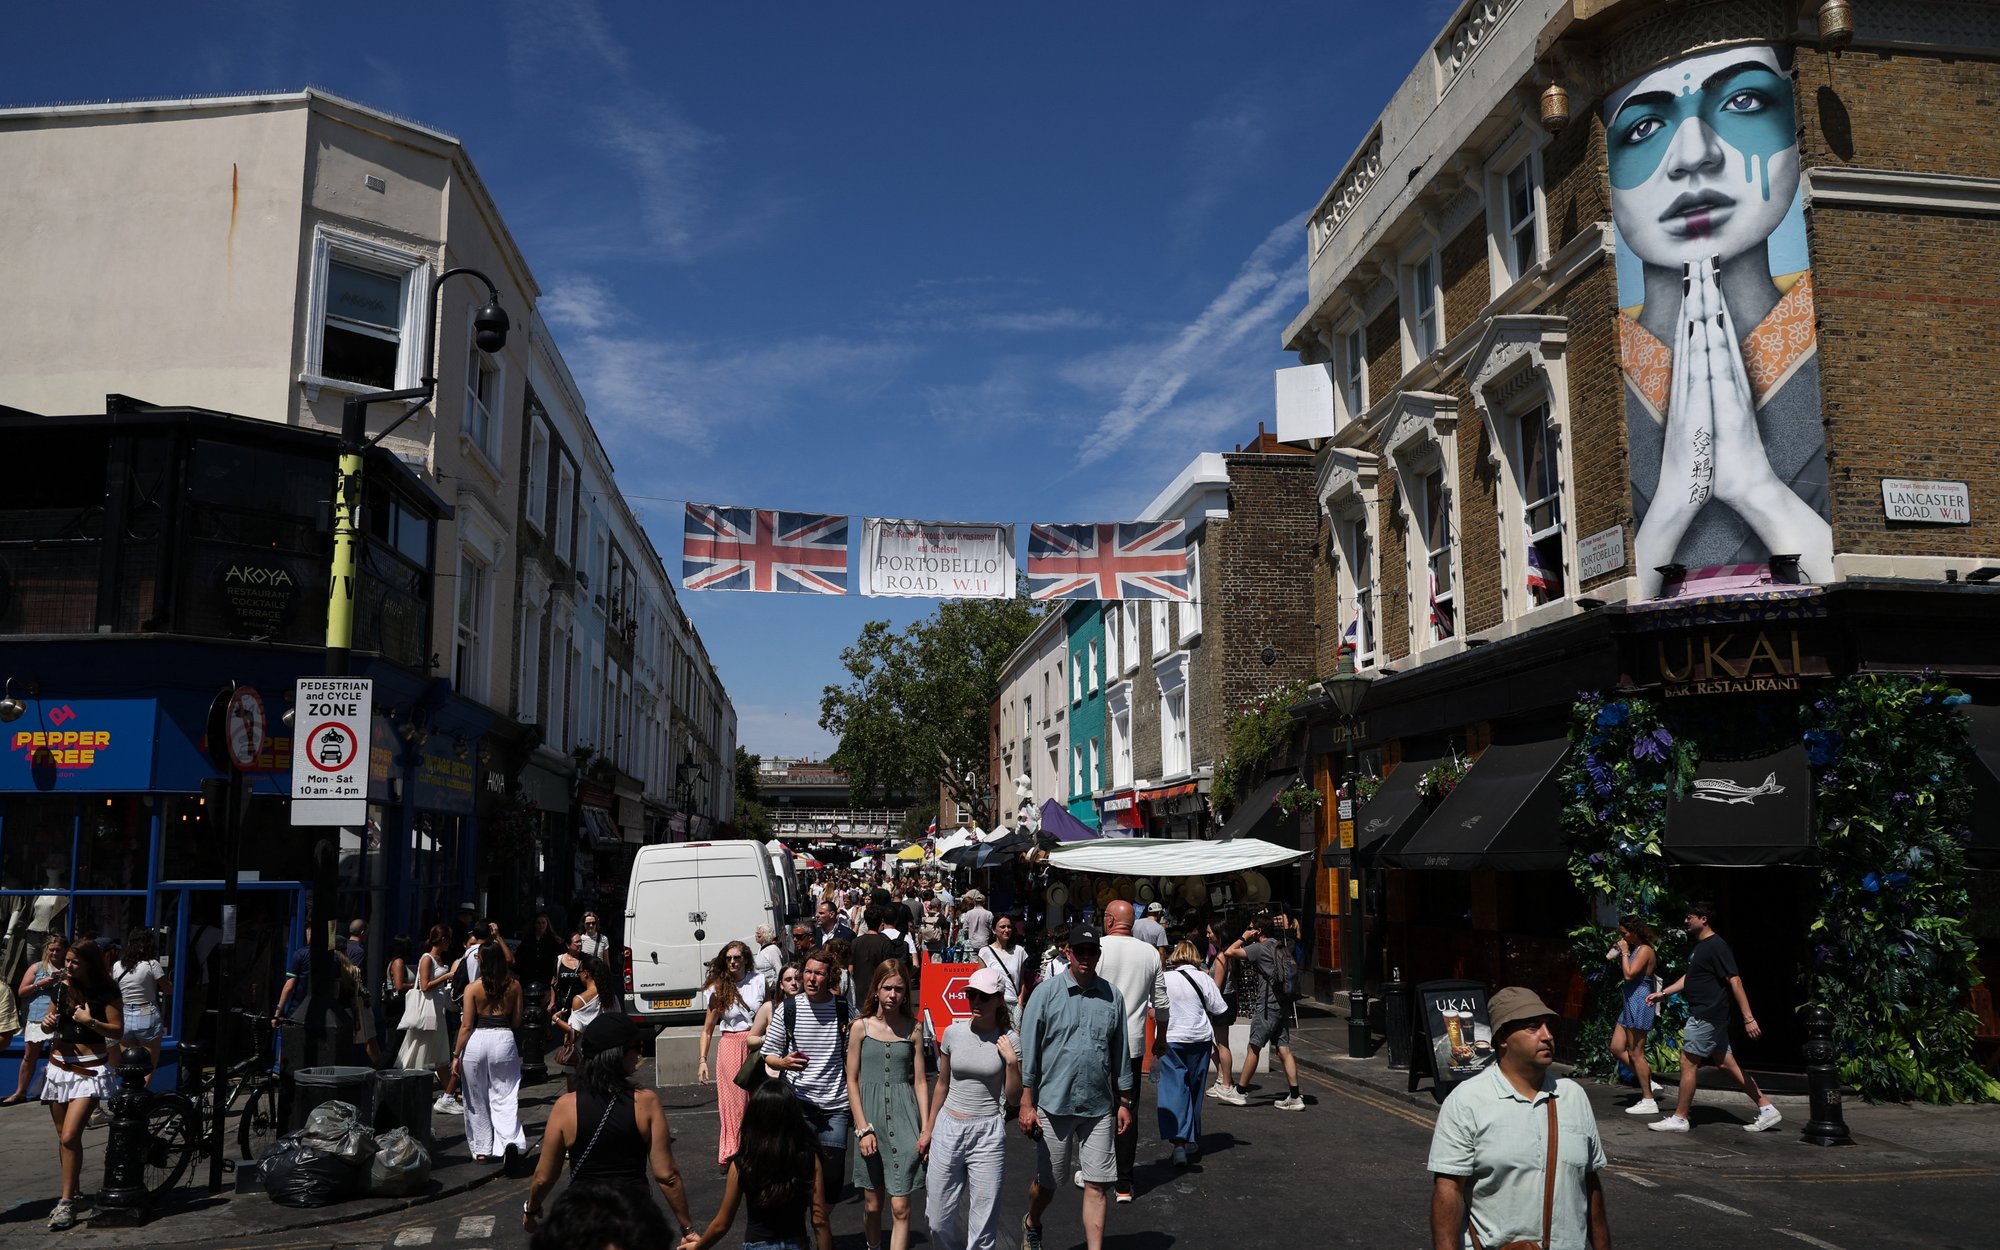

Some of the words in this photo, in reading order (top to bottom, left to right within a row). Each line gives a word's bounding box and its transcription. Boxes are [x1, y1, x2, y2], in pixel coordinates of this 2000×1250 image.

[1889, 492, 1965, 507] LANCASTER
[1894, 505, 1932, 519] ROAD.
[881, 529, 894, 538] The
[897, 530, 916, 541] Royal
[919, 530, 945, 541] Borough
[947, 532, 956, 541] of
[957, 532, 997, 543] Kensington
[917, 545, 928, 553] and
[931, 545, 958, 554] Chelsea
[1581, 544, 1621, 567] PORTOBELLO
[879, 556, 997, 574] PORTOBELLO
[225, 564, 293, 587] AKOYA
[227, 586, 291, 599] RESTAURANT
[231, 597, 286, 609] COCKTAILS
[237, 607, 281, 619] TERRACE
[1657, 630, 1801, 683] UKAI
[300, 682, 369, 691] PEDESTRIAN
[1664, 685, 1690, 698] BAR
[1696, 677, 1800, 695] RESTAURANT
[305, 692, 324, 701] and
[327, 692, 362, 701] CYCLE
[308, 703, 358, 717] ZONE
[15, 731, 111, 748] PEPPER
[30, 749, 96, 766] TREE
[307, 775, 329, 784] Mon
[336, 775, 354, 784] Sat
[486, 769, 506, 794] AKOYA
[300, 786, 312, 795] 10
[313, 787, 328, 795] am
[335, 786, 342, 795] 4
[344, 787, 359, 797] pm
[1435, 997, 1477, 1012] UKAI
